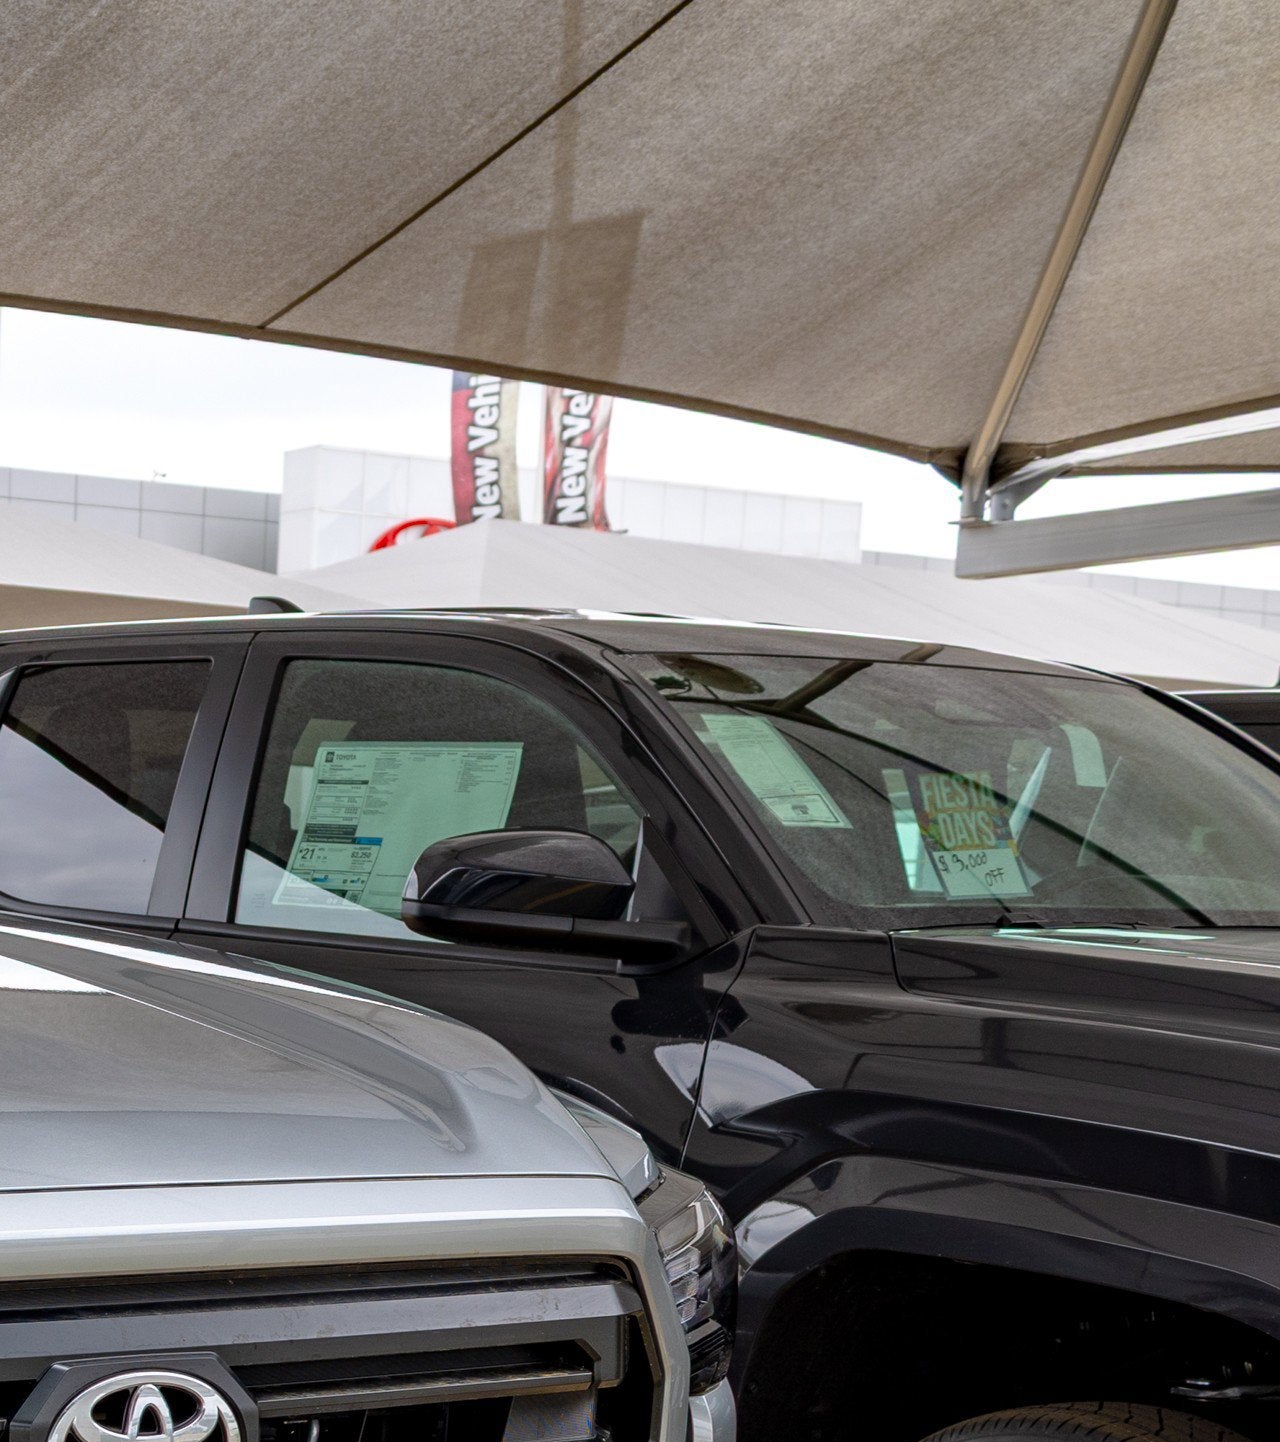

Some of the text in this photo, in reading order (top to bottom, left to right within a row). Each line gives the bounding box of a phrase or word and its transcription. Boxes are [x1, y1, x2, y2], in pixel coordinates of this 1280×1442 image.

[471, 456, 502, 521] New
[555, 446, 590, 524] New
[918, 771, 998, 812] FIESTA
[937, 810, 997, 850] DAYS
